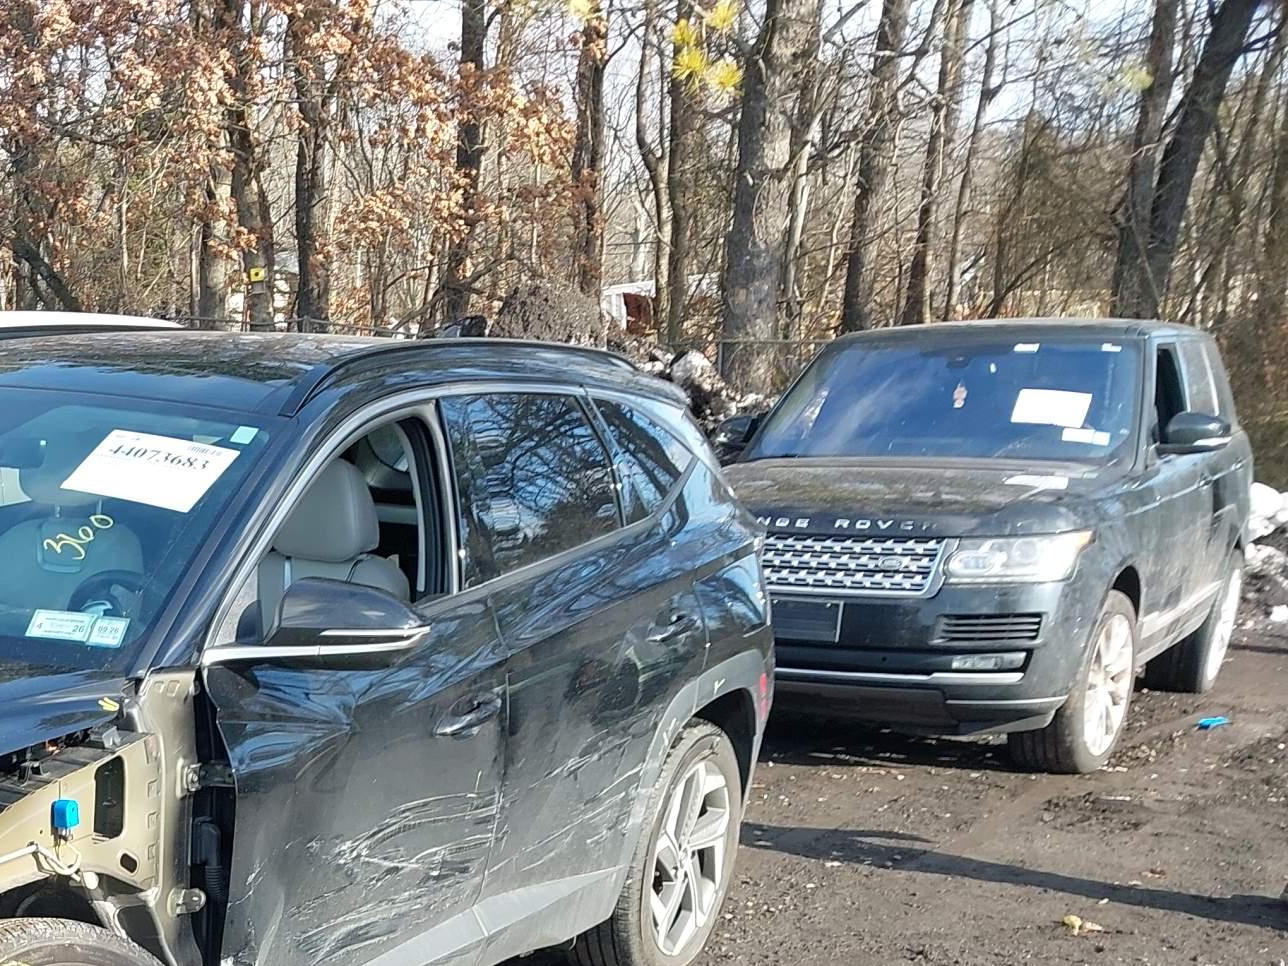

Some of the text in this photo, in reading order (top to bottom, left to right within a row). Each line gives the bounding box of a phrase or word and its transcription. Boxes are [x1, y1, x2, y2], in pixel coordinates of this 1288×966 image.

[108, 443, 210, 470] 44073683
[43, 514, 114, 560] 360
[72, 624, 85, 633] 26
